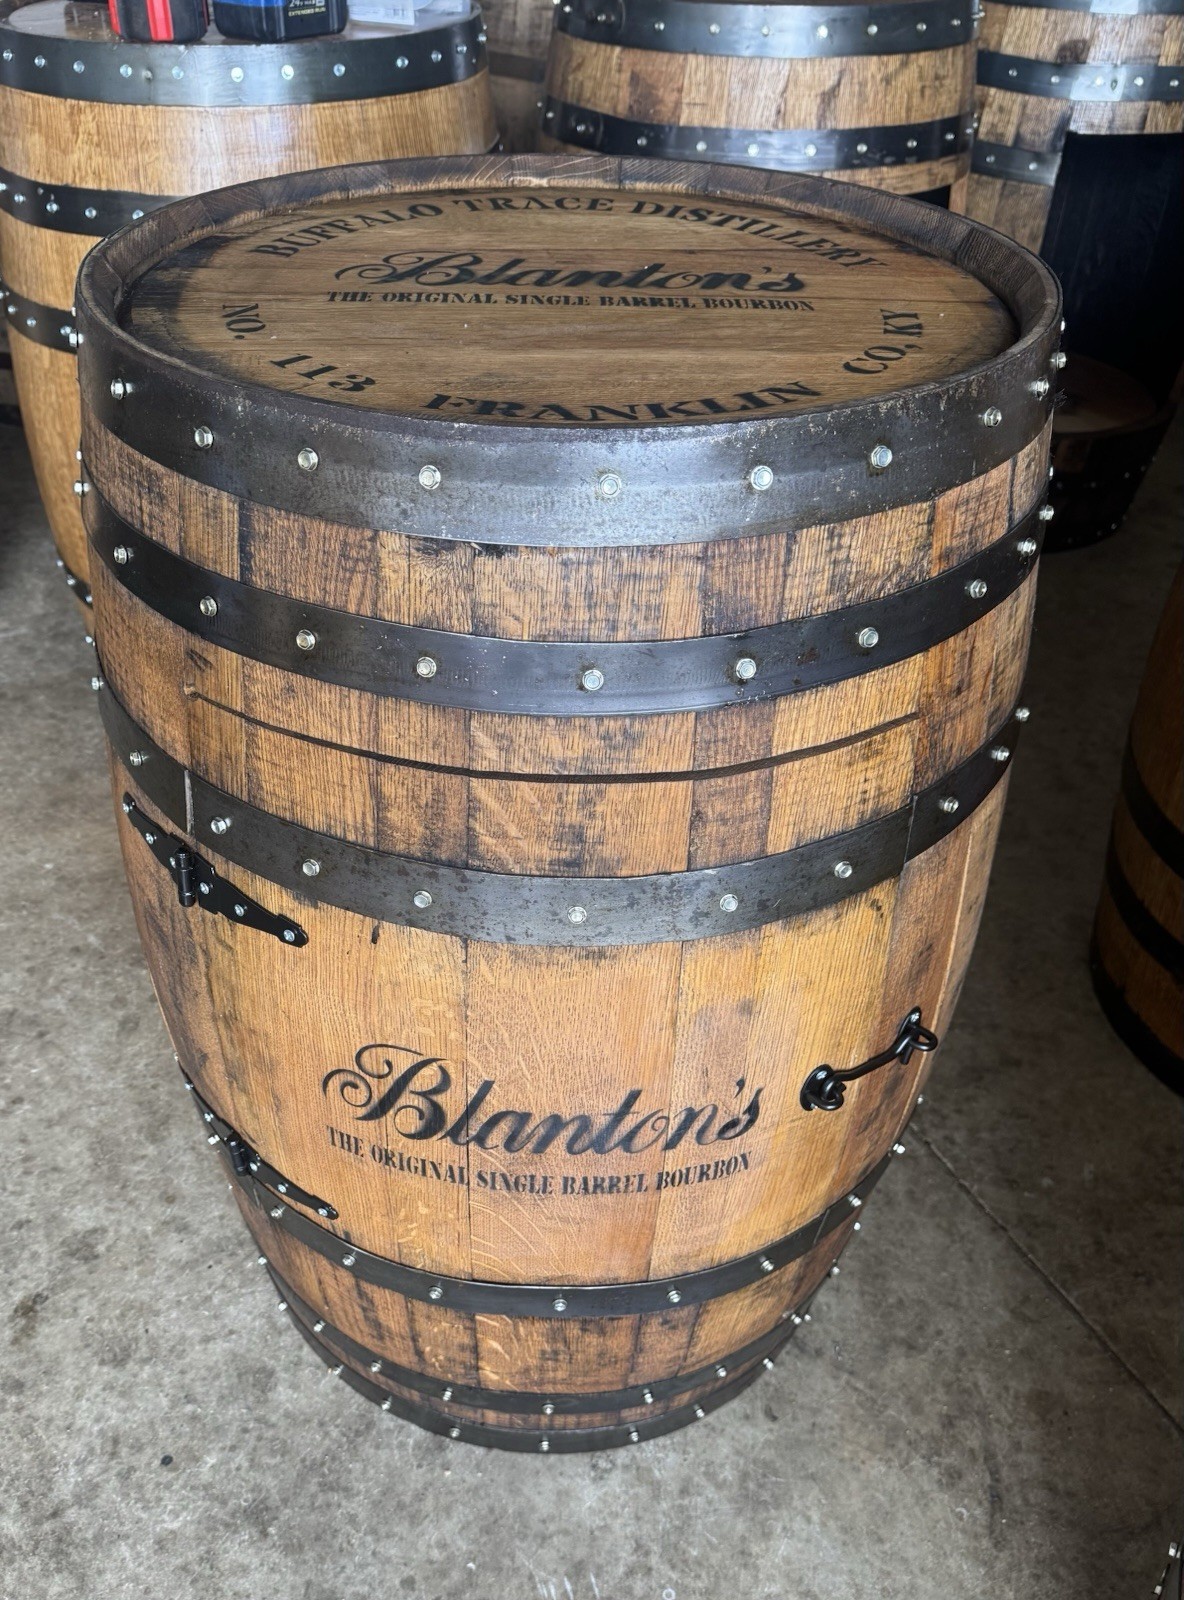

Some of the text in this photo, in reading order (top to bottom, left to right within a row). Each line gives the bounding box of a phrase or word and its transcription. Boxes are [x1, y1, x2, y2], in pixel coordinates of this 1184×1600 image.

[249, 197, 889, 268] BUFFALO TRACE DISTILLERY
[327, 292, 815, 313] THE ORIGINAL SINGLE BARREL BOURBON
[334, 251, 806, 292] Blanton's
[222, 302, 375, 393] NO. 113
[421, 381, 820, 421] FRANKLIN
[879, 308, 923, 338] KY
[322, 1043, 764, 1155] Blanton's
[326, 1124, 752, 1196] THE ORIGINAL SINGLE BARREL BOURBON
